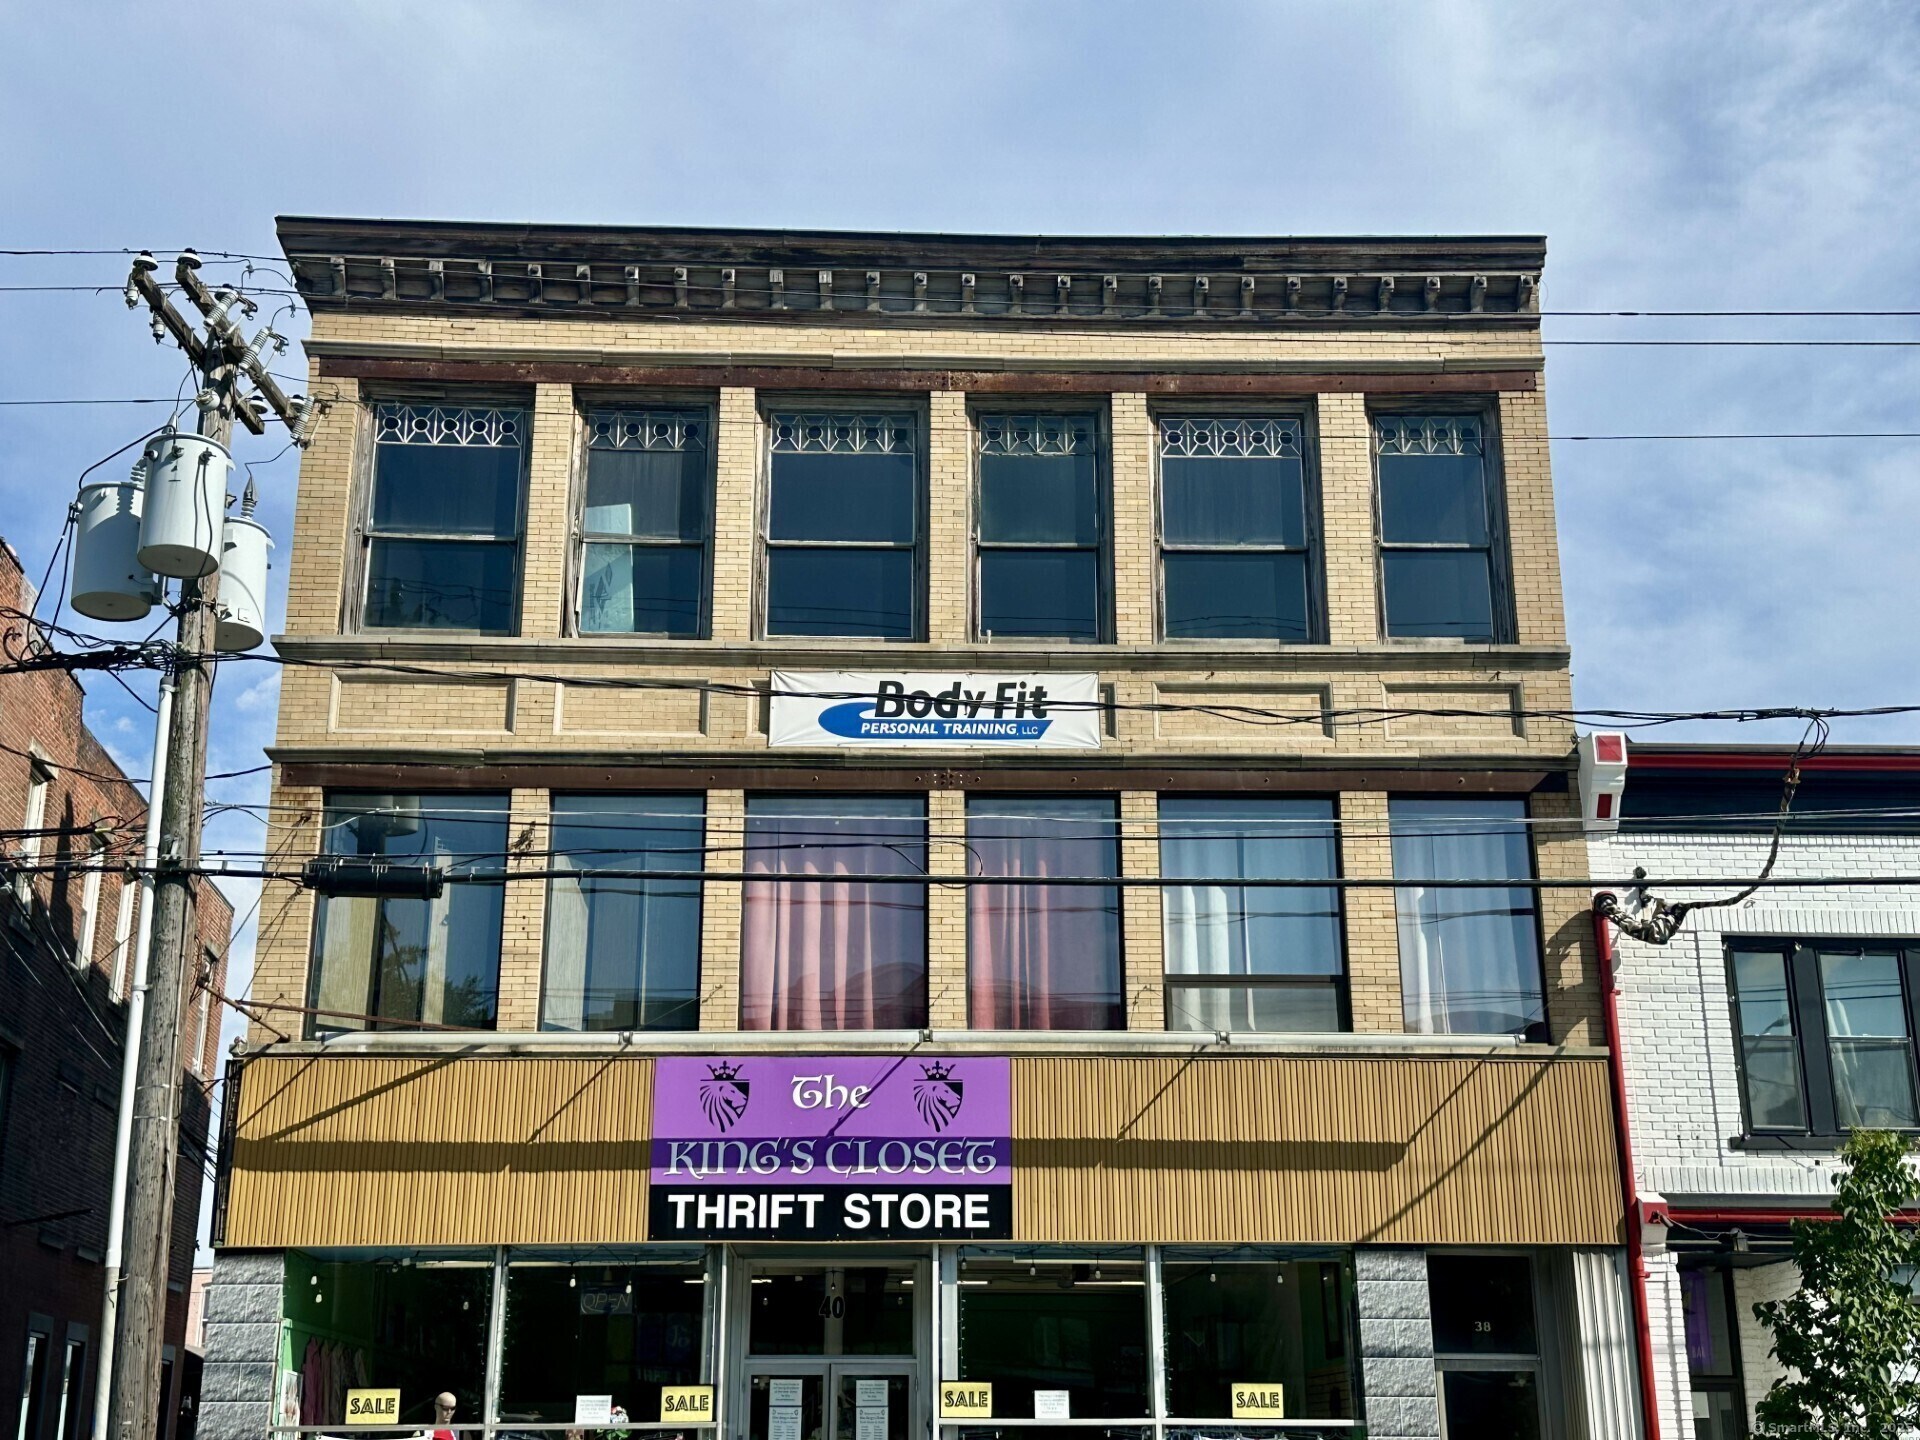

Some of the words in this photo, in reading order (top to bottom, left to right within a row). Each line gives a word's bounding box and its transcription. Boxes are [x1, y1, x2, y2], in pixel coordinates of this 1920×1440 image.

[875, 681, 986, 719] Body
[994, 681, 1048, 719] Fit
[861, 722, 938, 735] PERSONAL
[1022, 726, 1039, 735] LLC
[791, 1074, 872, 1110] The
[664, 1138, 818, 1179] KING'S
[826, 1137, 997, 1179] CLOSET
[667, 1194, 824, 1229] THRIFT
[843, 1193, 990, 1229] STORE
[819, 1295, 845, 1319] 40
[1474, 1321, 1491, 1332] 38
[350, 1398, 395, 1414] SALE
[665, 1395, 709, 1411] SALE
[944, 1390, 988, 1407] SALE
[1236, 1391, 1280, 1408] SALE
